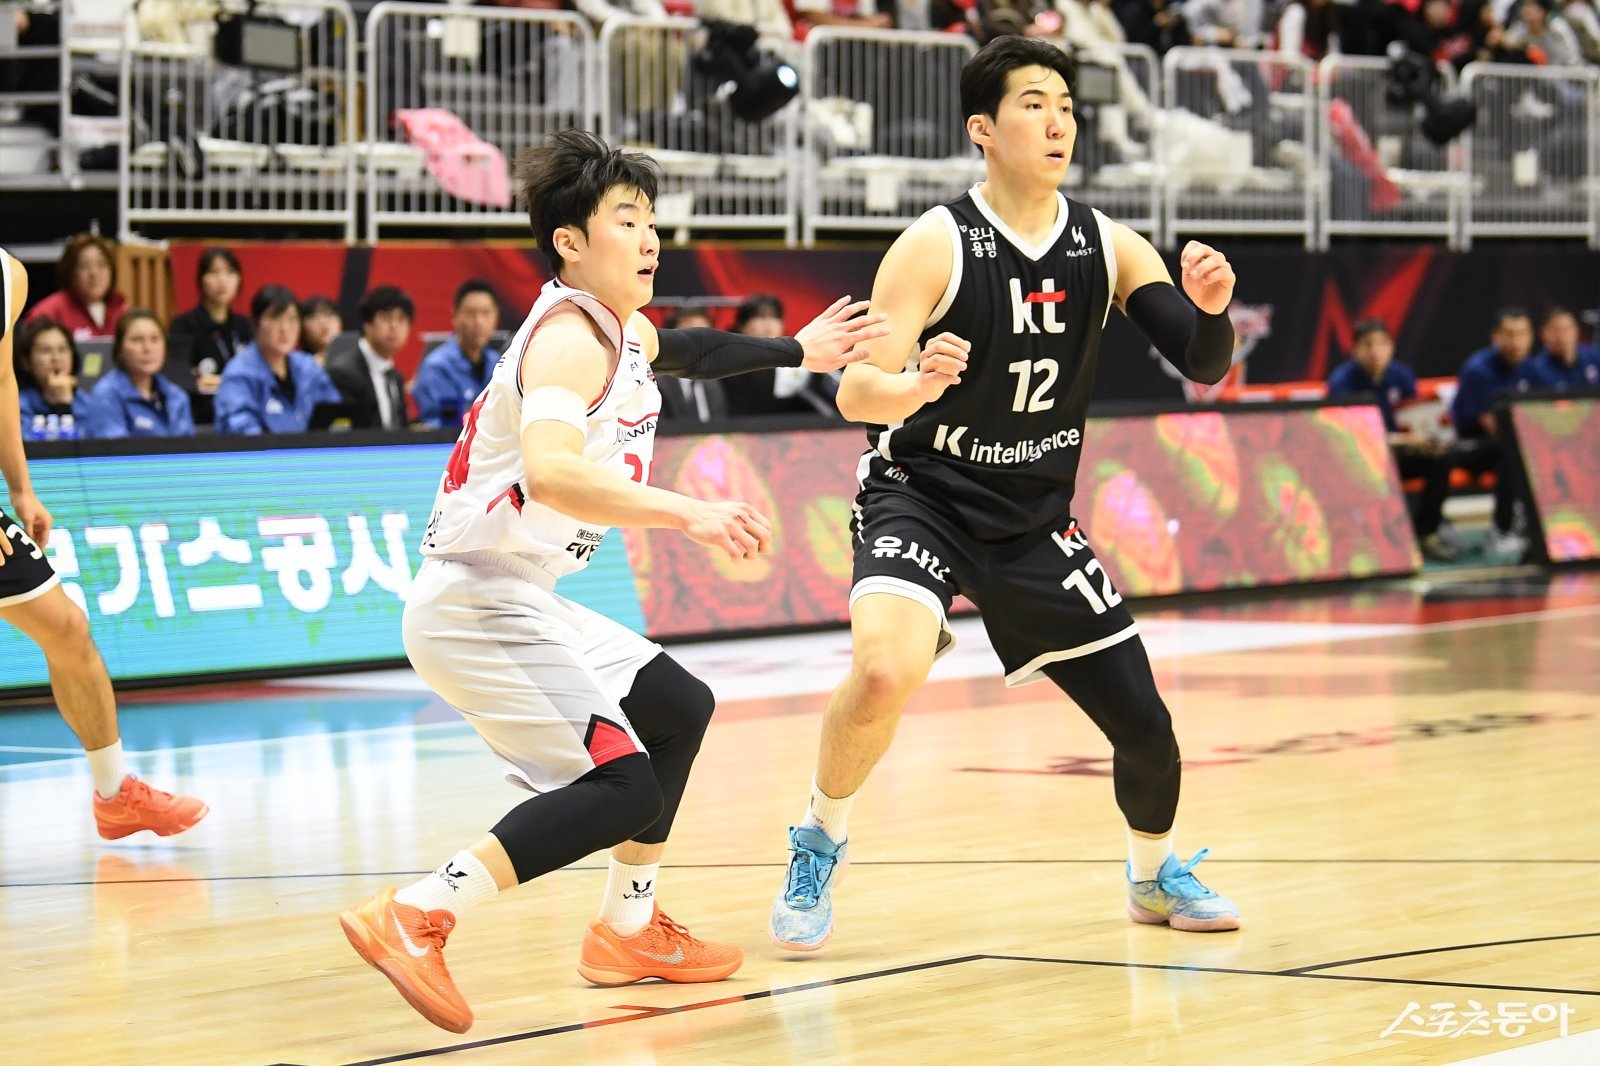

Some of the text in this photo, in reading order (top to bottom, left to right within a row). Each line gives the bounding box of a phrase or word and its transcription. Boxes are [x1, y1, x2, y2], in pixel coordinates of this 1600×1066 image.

[969, 227, 995, 241] 모나
[971, 241, 997, 258] 용평
[1009, 277, 1066, 334] kt
[1008, 358, 1059, 413] 12
[933, 424, 968, 457] K
[1061, 558, 1123, 614] 12
